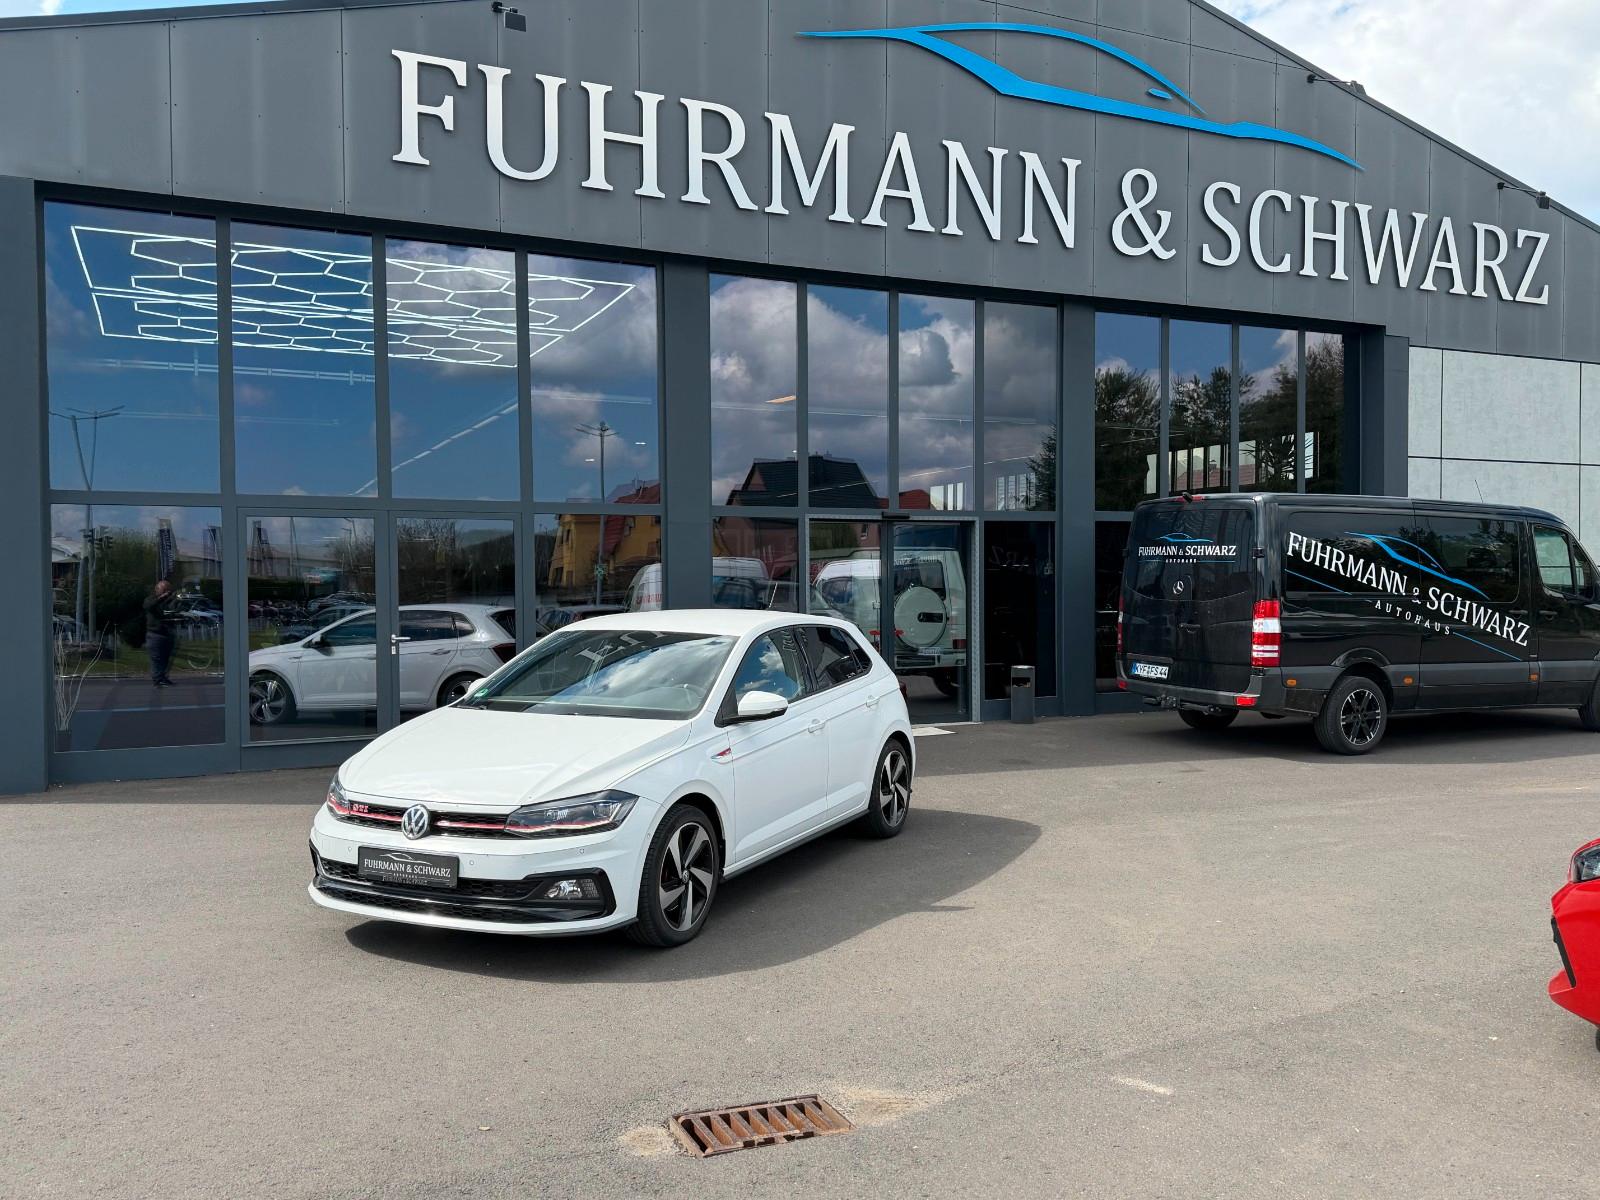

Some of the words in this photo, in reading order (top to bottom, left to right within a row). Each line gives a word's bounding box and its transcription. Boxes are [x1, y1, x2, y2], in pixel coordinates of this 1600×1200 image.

[391, 48, 1082, 249] FUHRMANN
[1111, 168, 1177, 260] &
[1202, 181, 1550, 305] SCHWARZ
[1138, 545, 1178, 557] FUHRMANN
[1179, 548, 1184, 556] &
[1185, 544, 1237, 556] SCHWARZ
[1286, 531, 1408, 596] FUHRMANN
[1412, 586, 1422, 605] &
[1426, 586, 1531, 647] SCHWARZ
[1374, 599, 1451, 635] AUTOHAUS
[364, 858, 405, 873] FUHRMANN
[405, 864, 413, 873] &
[413, 864, 451, 878] SCHWARZ
